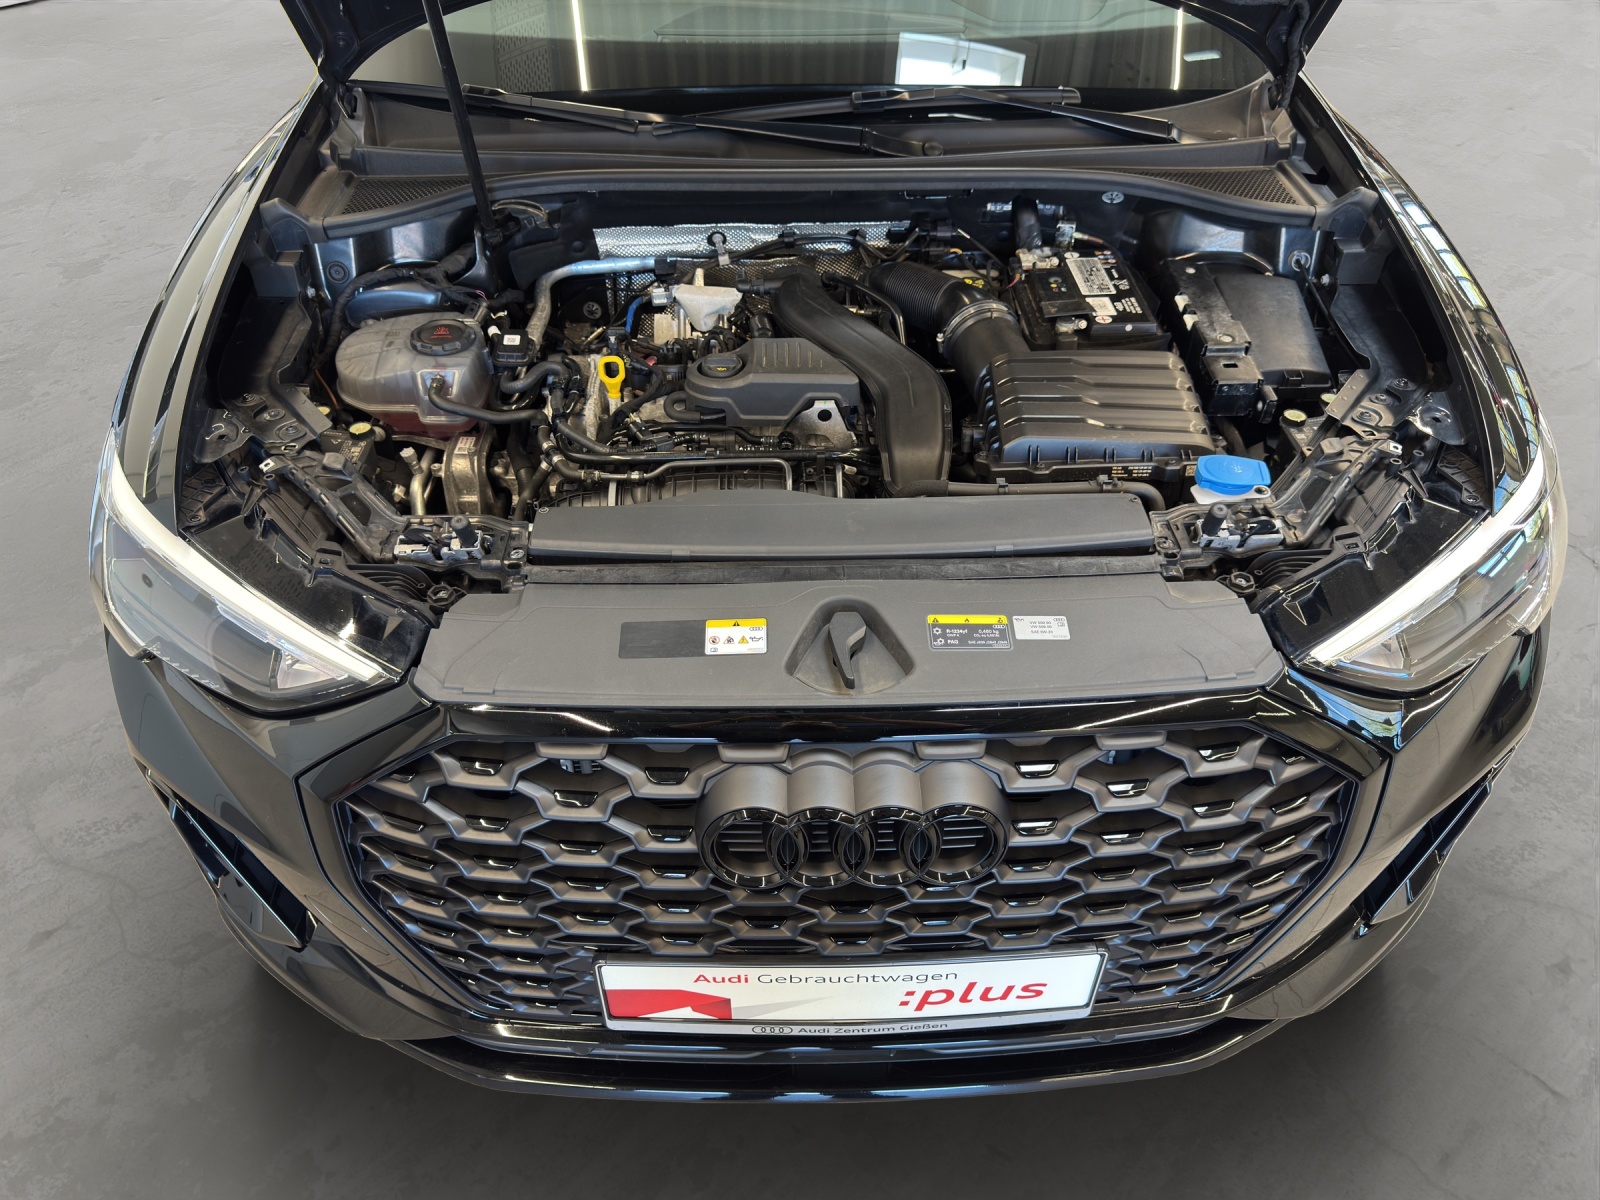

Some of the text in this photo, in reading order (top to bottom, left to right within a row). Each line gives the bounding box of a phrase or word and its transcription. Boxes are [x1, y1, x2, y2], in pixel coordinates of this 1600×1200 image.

[693, 972, 958, 984] Audi Gebrauchtwagen
[898, 981, 1048, 1012] :plus
[834, 1026, 895, 1034] Zentrum
[900, 1022, 948, 1031] Gießen
